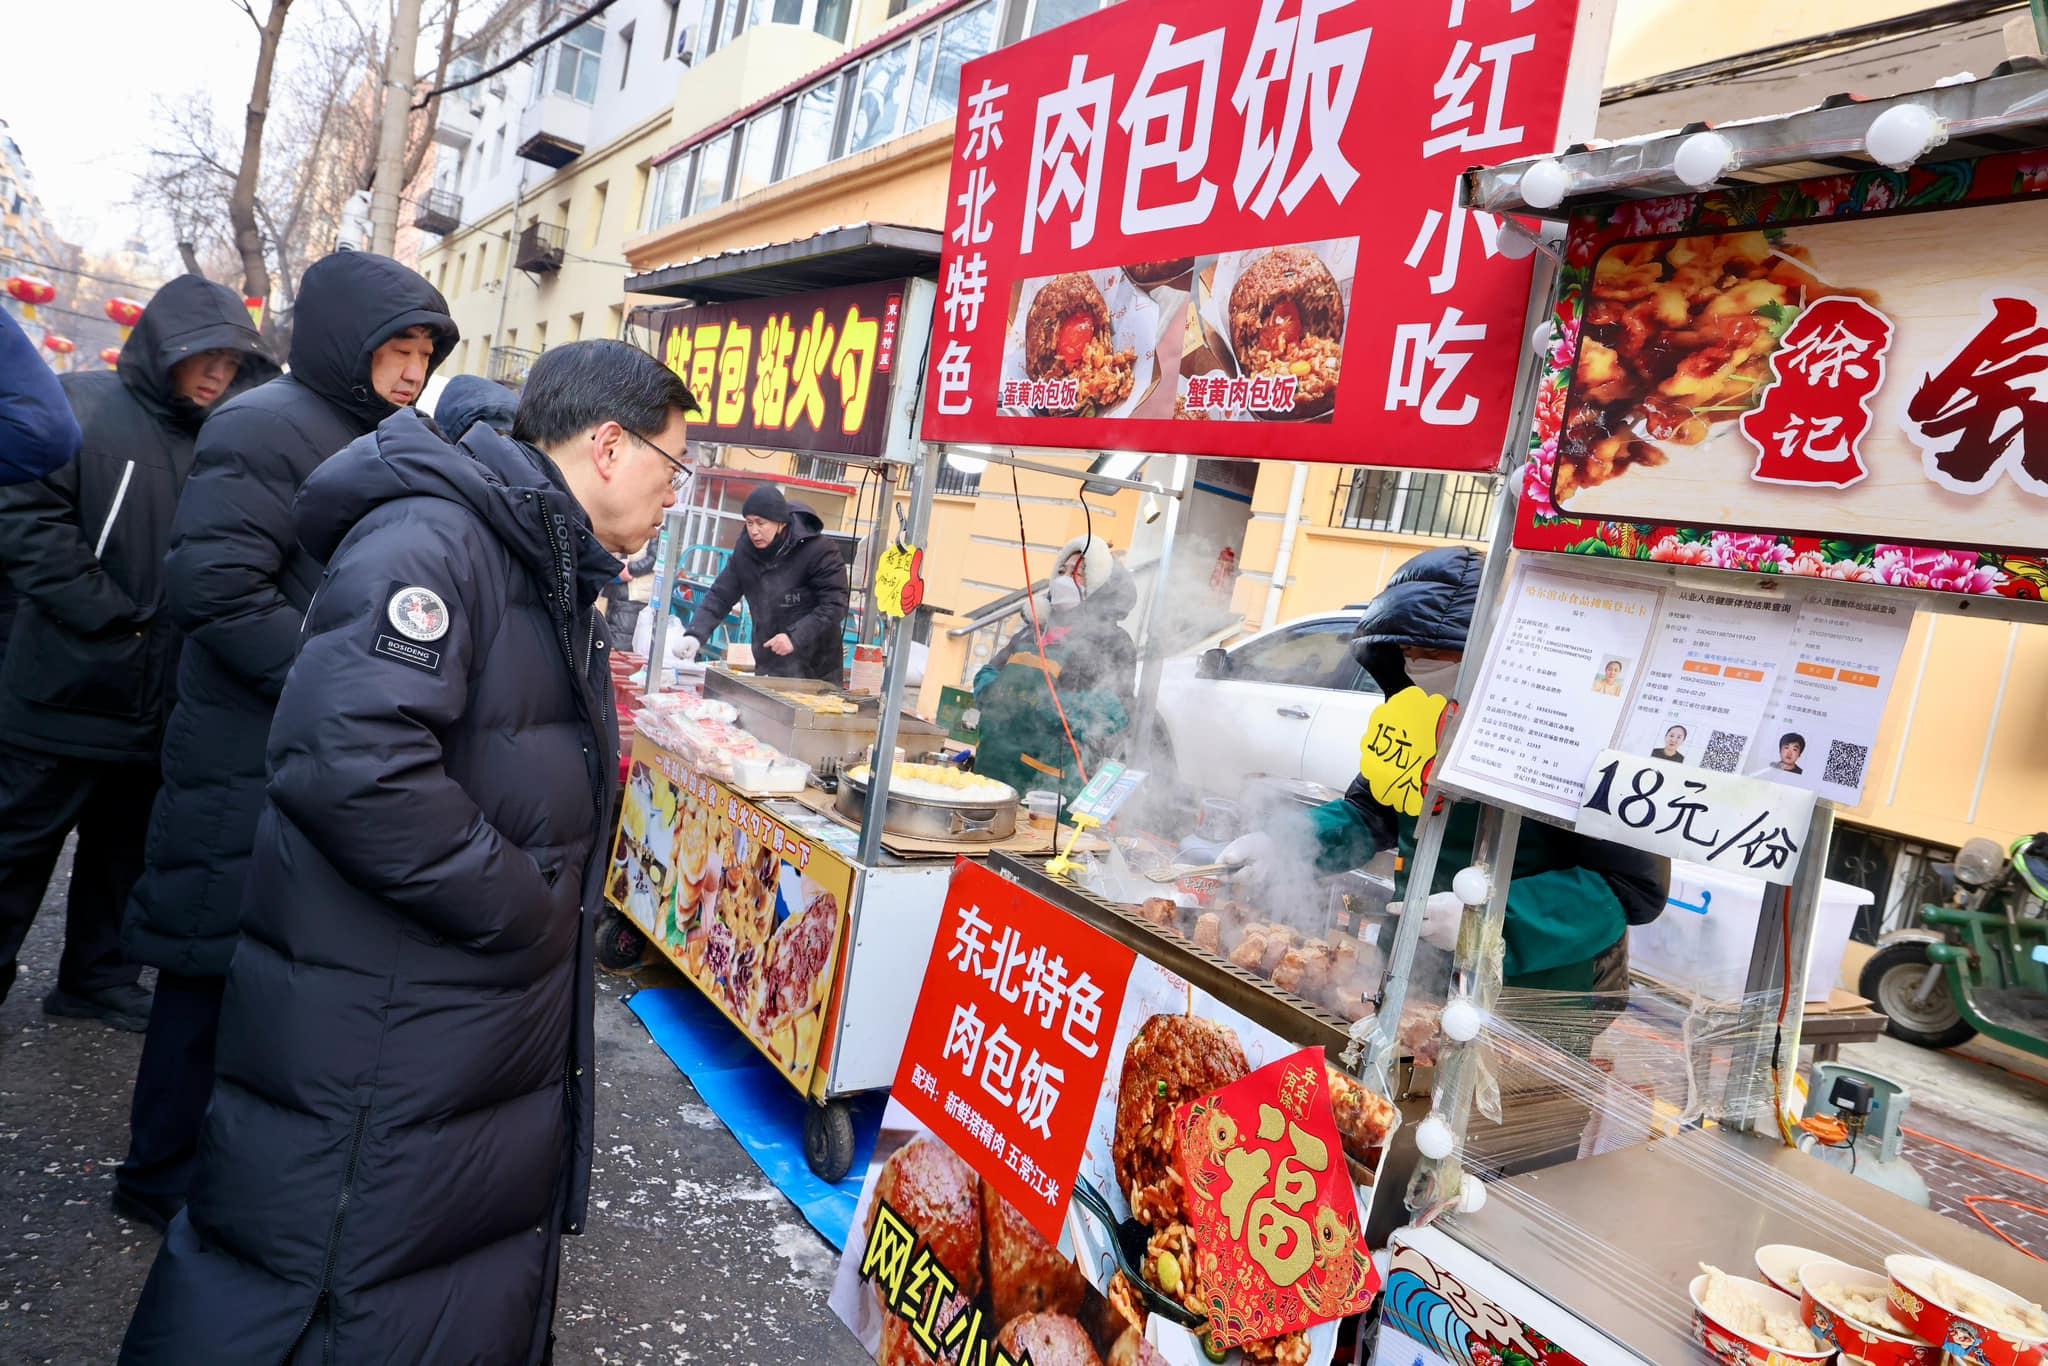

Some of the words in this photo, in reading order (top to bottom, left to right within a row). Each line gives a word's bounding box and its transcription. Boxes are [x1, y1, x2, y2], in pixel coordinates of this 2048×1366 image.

[1020, 0, 1372, 255] 肉包饭
[937, 79, 1009, 417] 东北特色
[1385, 0, 1536, 426] 红小吃
[753, 303, 880, 436] 粘火勺
[1004, 378, 1078, 409] 蛋黄肉包饭
[1186, 376, 1297, 411] 蟹黄肉包饭
[1773, 319, 1875, 464] 徐记
[554, 514, 573, 613] BOSIDENG
[387, 640, 430, 659] BOSIDENG
[1367, 723, 1422, 811] 15元/个
[1582, 758, 1798, 872] 18元/份
[946, 903, 1106, 1060] 东北特色
[942, 1002, 1067, 1142] 肉包饭
[943, 1090, 1007, 1160] 新鲜猪精肉
[1004, 1143, 1061, 1207] 五常江米
[1221, 1102, 1329, 1287] 福
[862, 1205, 1032, 1366] 网红小
